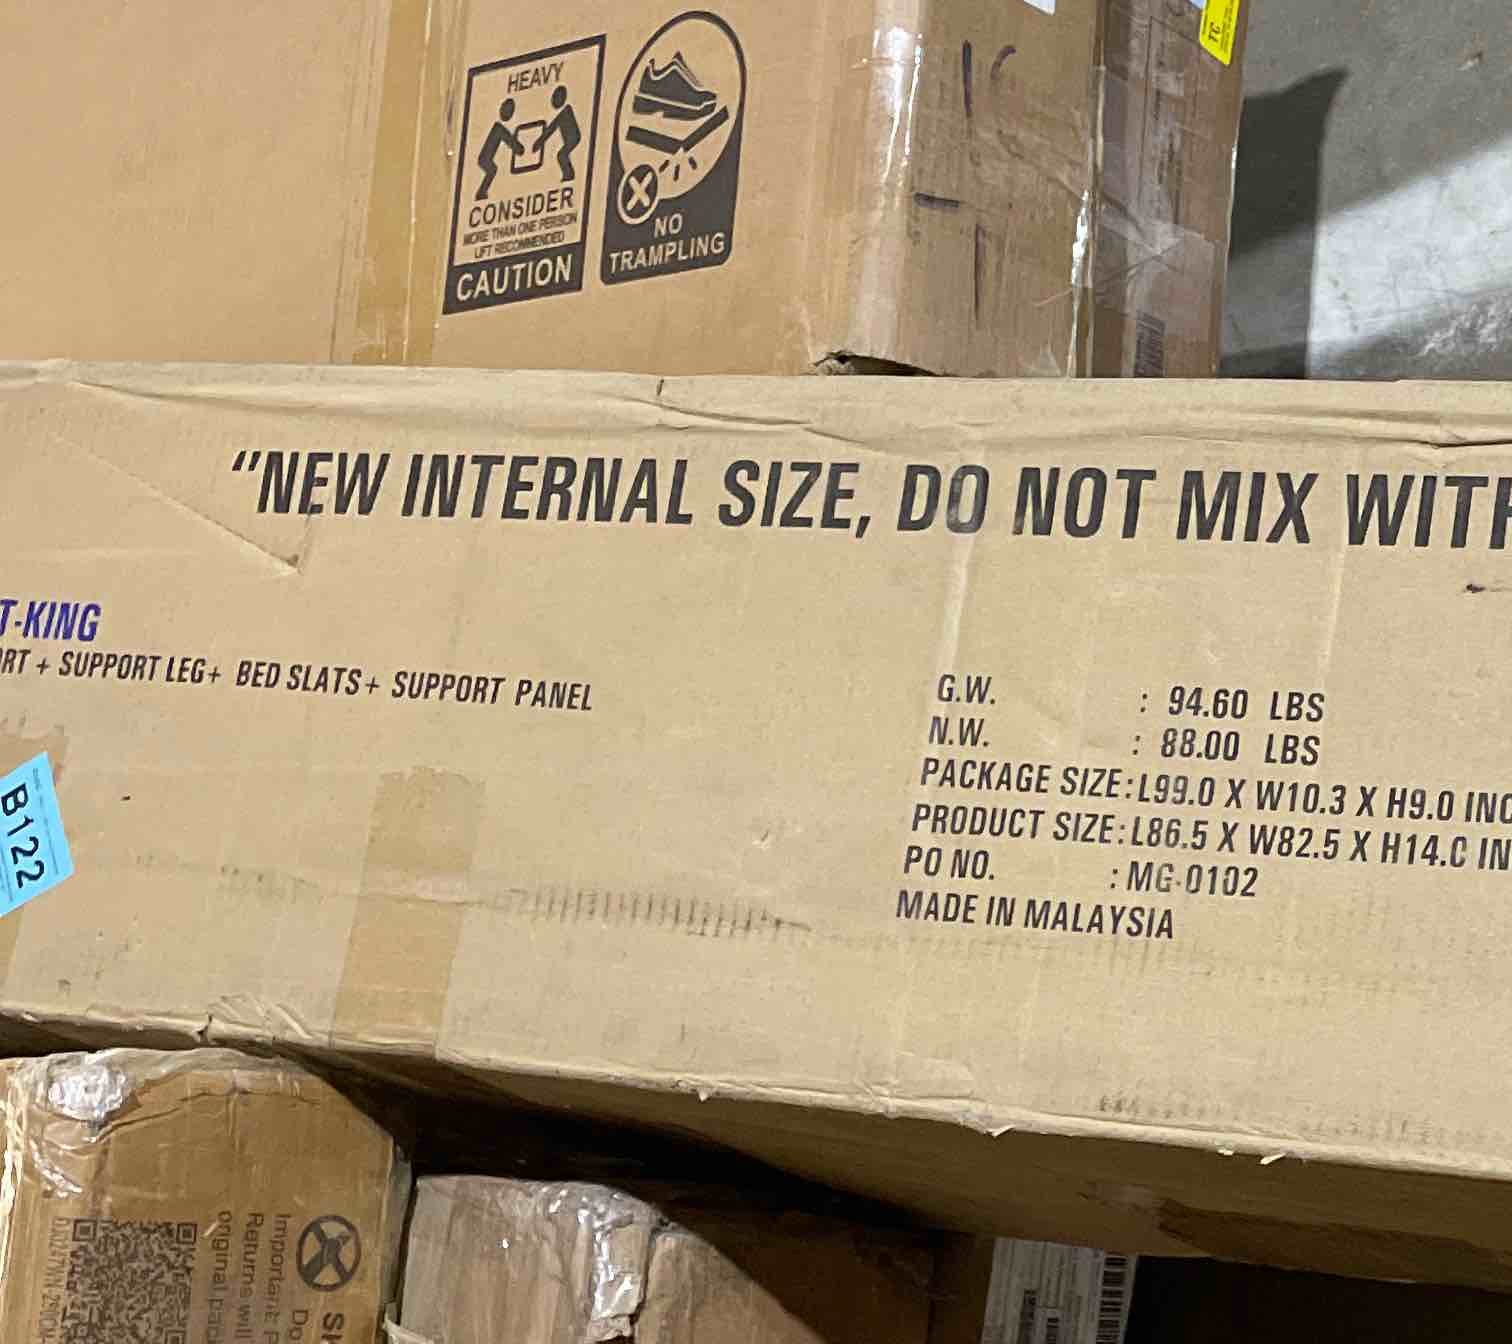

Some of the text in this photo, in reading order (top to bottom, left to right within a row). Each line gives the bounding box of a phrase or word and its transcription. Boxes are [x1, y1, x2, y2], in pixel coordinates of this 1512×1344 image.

[507, 62, 565, 93] HEAVY
[469, 187, 574, 228] CONSIDER
[491, 222, 517, 241] THAN
[654, 213, 683, 238] NO
[609, 232, 725, 273] TRAMPLING
[456, 254, 573, 301] CAUTION
[401, 454, 694, 526] INTERNAL
[717, 459, 871, 539] SIZE,
[896, 464, 991, 534] DO
[1012, 467, 1157, 539] NOT
[1176, 470, 1320, 545] MIX
[59, 650, 162, 681] SUPPORT
[236, 659, 281, 690] BED
[391, 670, 506, 706] SUPPORT
[514, 679, 594, 712] PANEL
[936, 674, 997, 705] G.W.
[1168, 685, 1250, 721] 94.60
[1269, 690, 1326, 723] LBS
[928, 715, 991, 749] N.W.
[1160, 727, 1241, 763] 88.00
[1264, 733, 1321, 767] LBS
[920, 757, 1053, 795] PACKAGE
[1223, 777, 1247, 810] X
[1256, 780, 1347, 816] W10.3
[1355, 785, 1379, 818] X
[1386, 787, 1456, 822] H9.0
[1, 783, 46, 889] B122
[912, 803, 1046, 840] PRODUCT
[1217, 821, 1241, 854] X
[1249, 823, 1342, 861] W82.5
[1350, 830, 1372, 863] X
[903, 845, 943, 876] PO
[950, 848, 996, 881] NO.
[896, 890, 1175, 940] MADE IN MALAYSIA
[210, 1210, 233, 1292] original
[239, 1212, 265, 1297] Returns
[236, 1304, 256, 1340] will
[288, 1309, 309, 1340] Do
